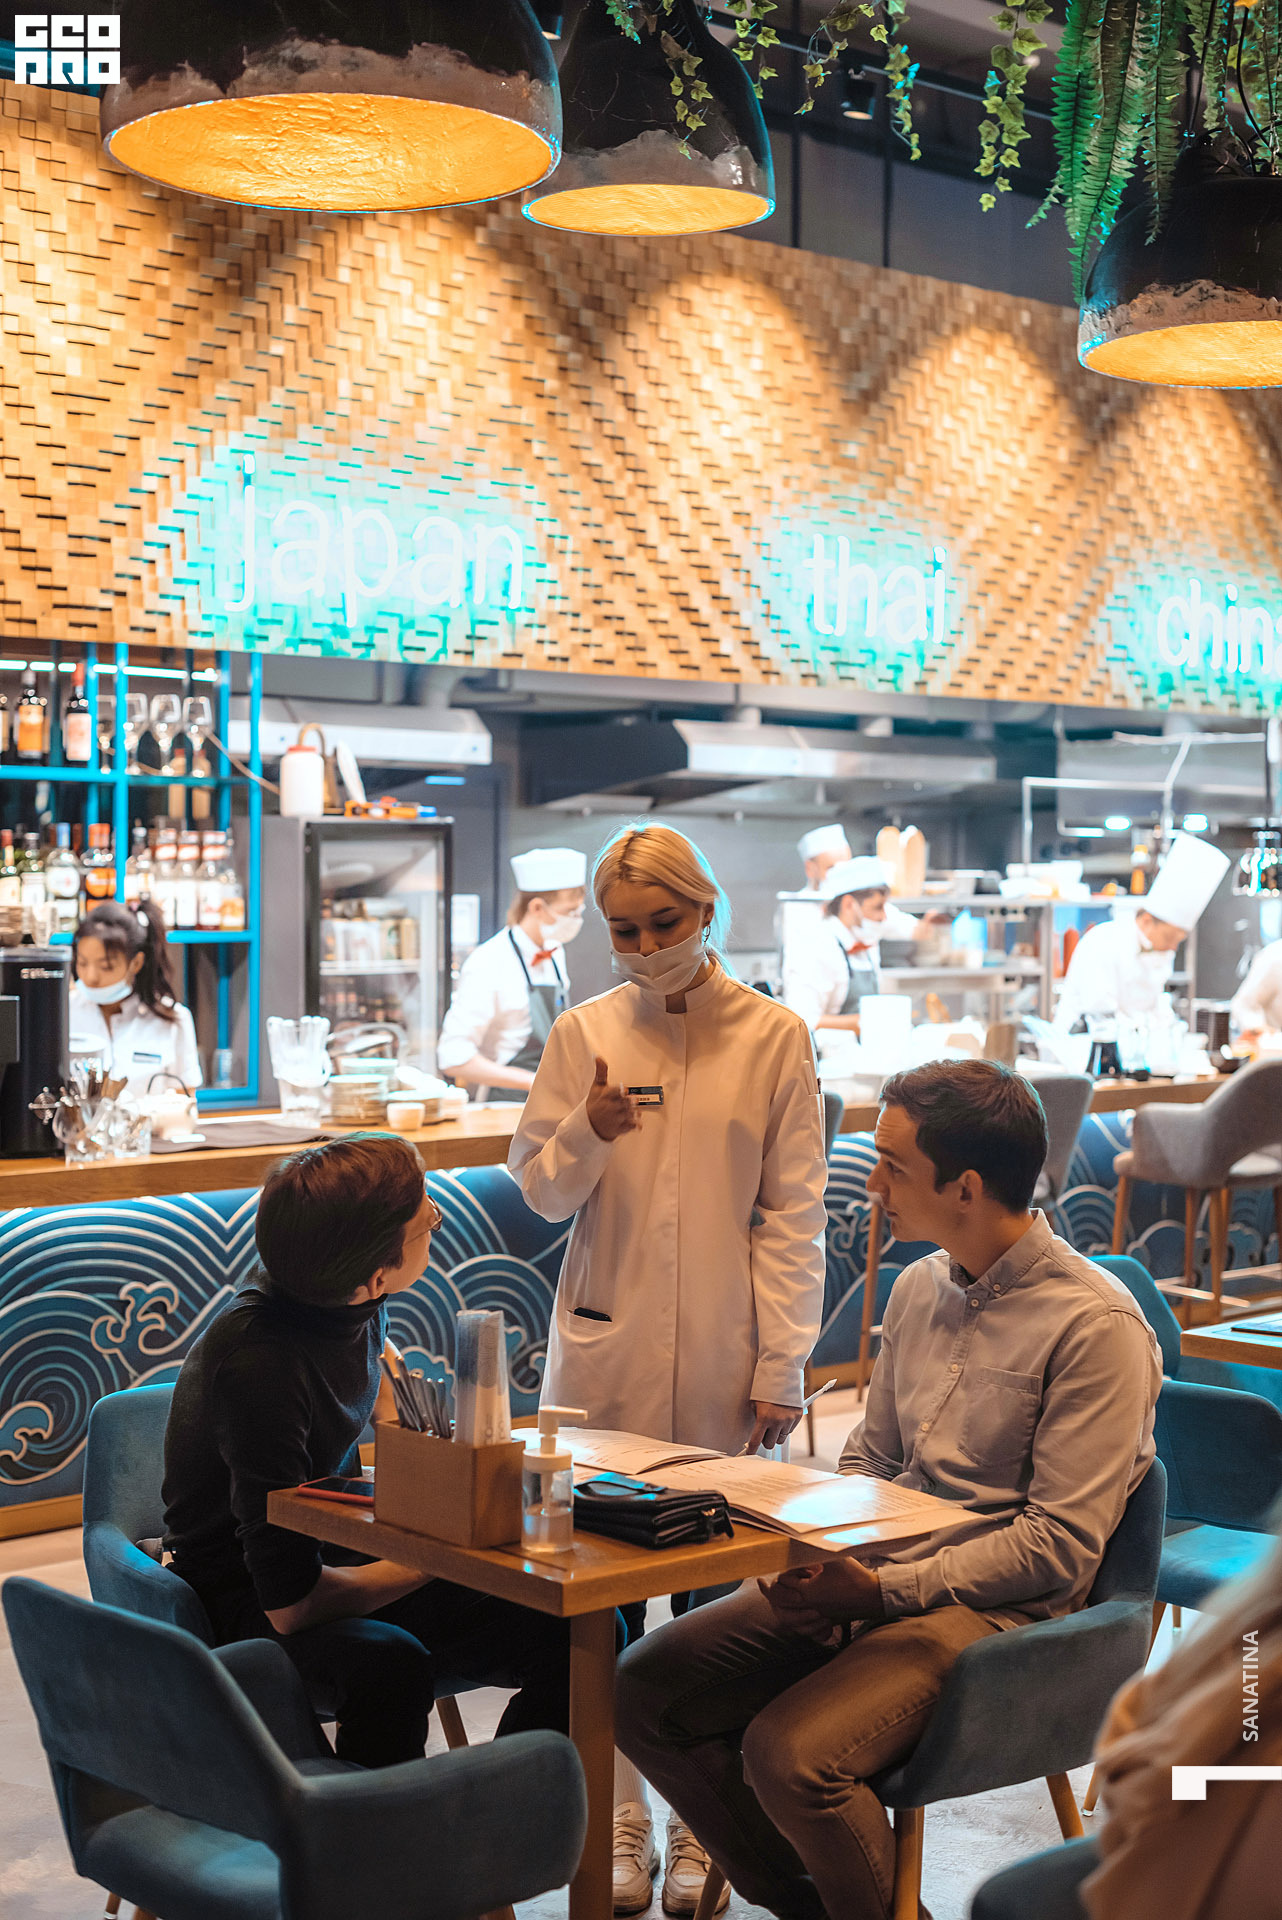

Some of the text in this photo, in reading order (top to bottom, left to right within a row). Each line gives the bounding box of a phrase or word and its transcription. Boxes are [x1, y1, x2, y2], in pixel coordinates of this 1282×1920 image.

[225, 454, 523, 628] japan
[803, 533, 946, 644] thai
[1157, 578, 1282, 679] chin
